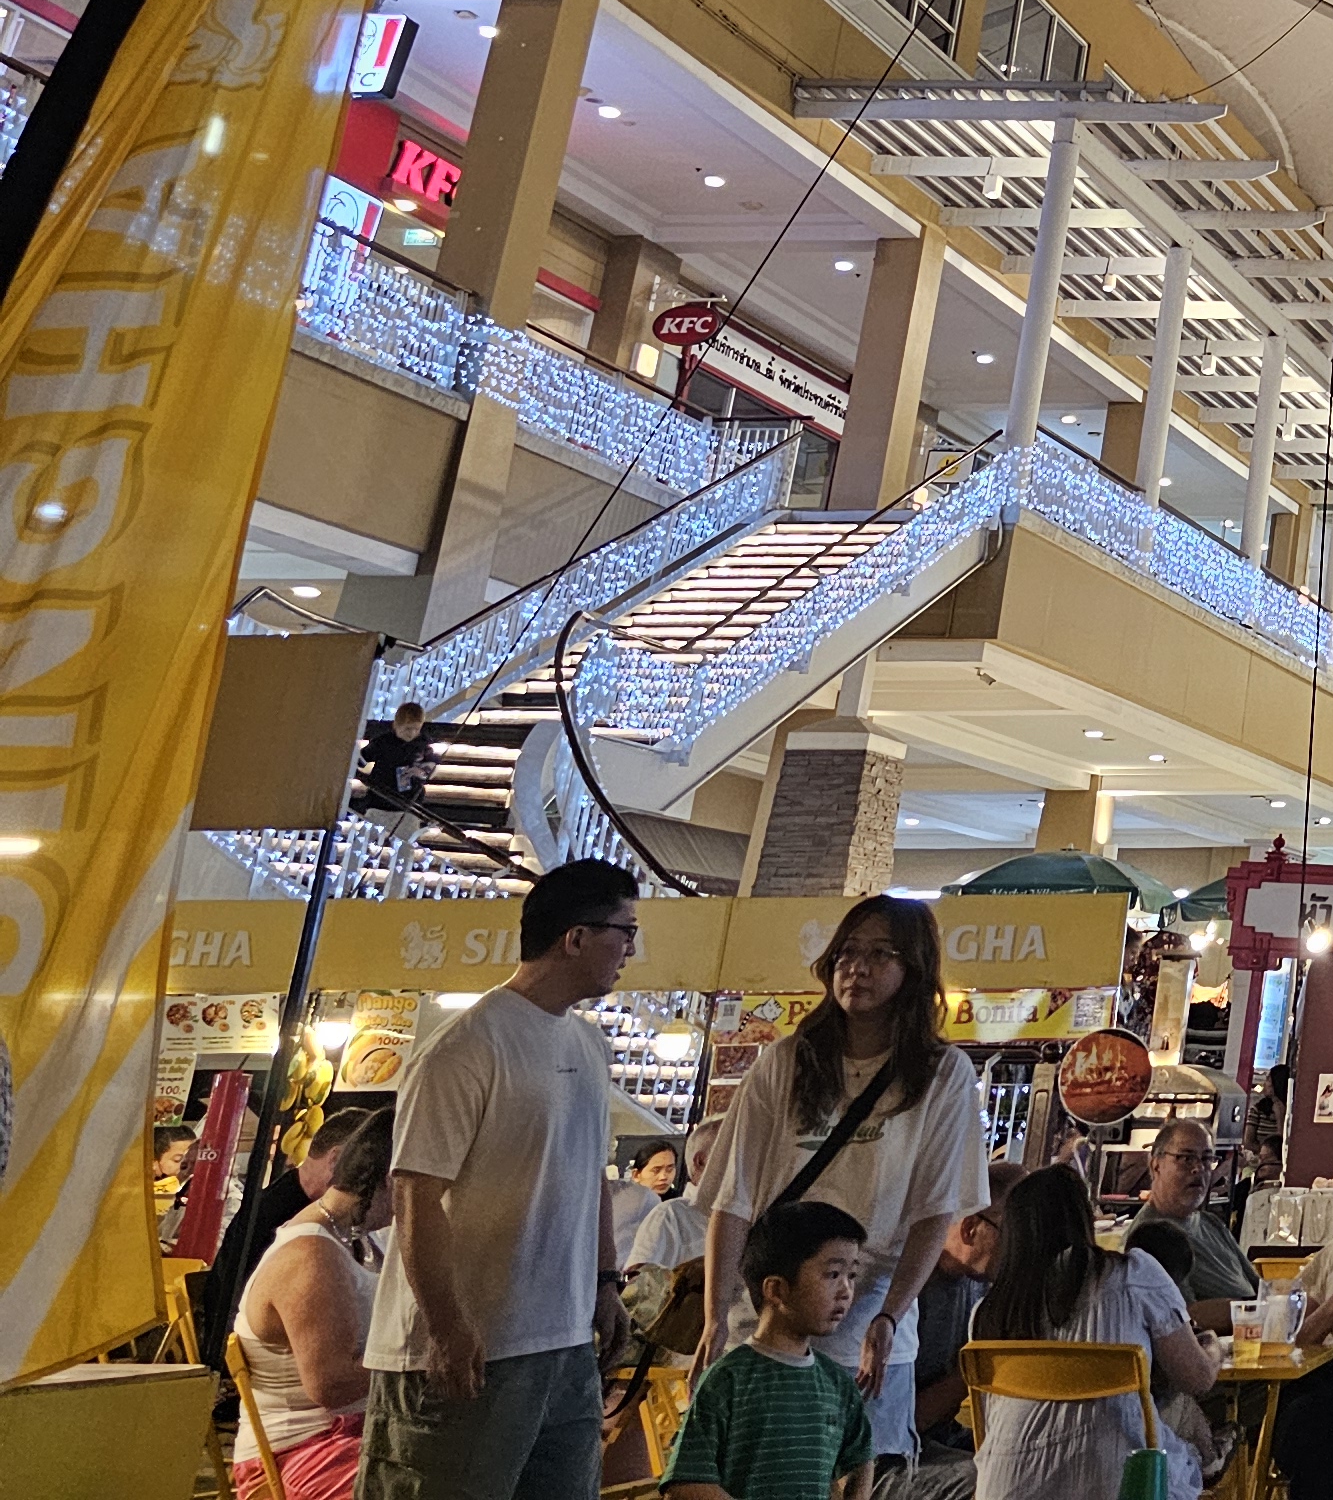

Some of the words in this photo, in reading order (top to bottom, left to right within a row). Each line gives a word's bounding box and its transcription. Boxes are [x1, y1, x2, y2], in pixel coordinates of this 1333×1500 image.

[391, 138, 462, 202] KF
[660, 316, 713, 334] KFC
[169, 930, 252, 967] GHA
[946, 924, 1047, 962] GHA
[357, 993, 418, 1014] Mango
[953, 998, 1040, 1024] Bonita
